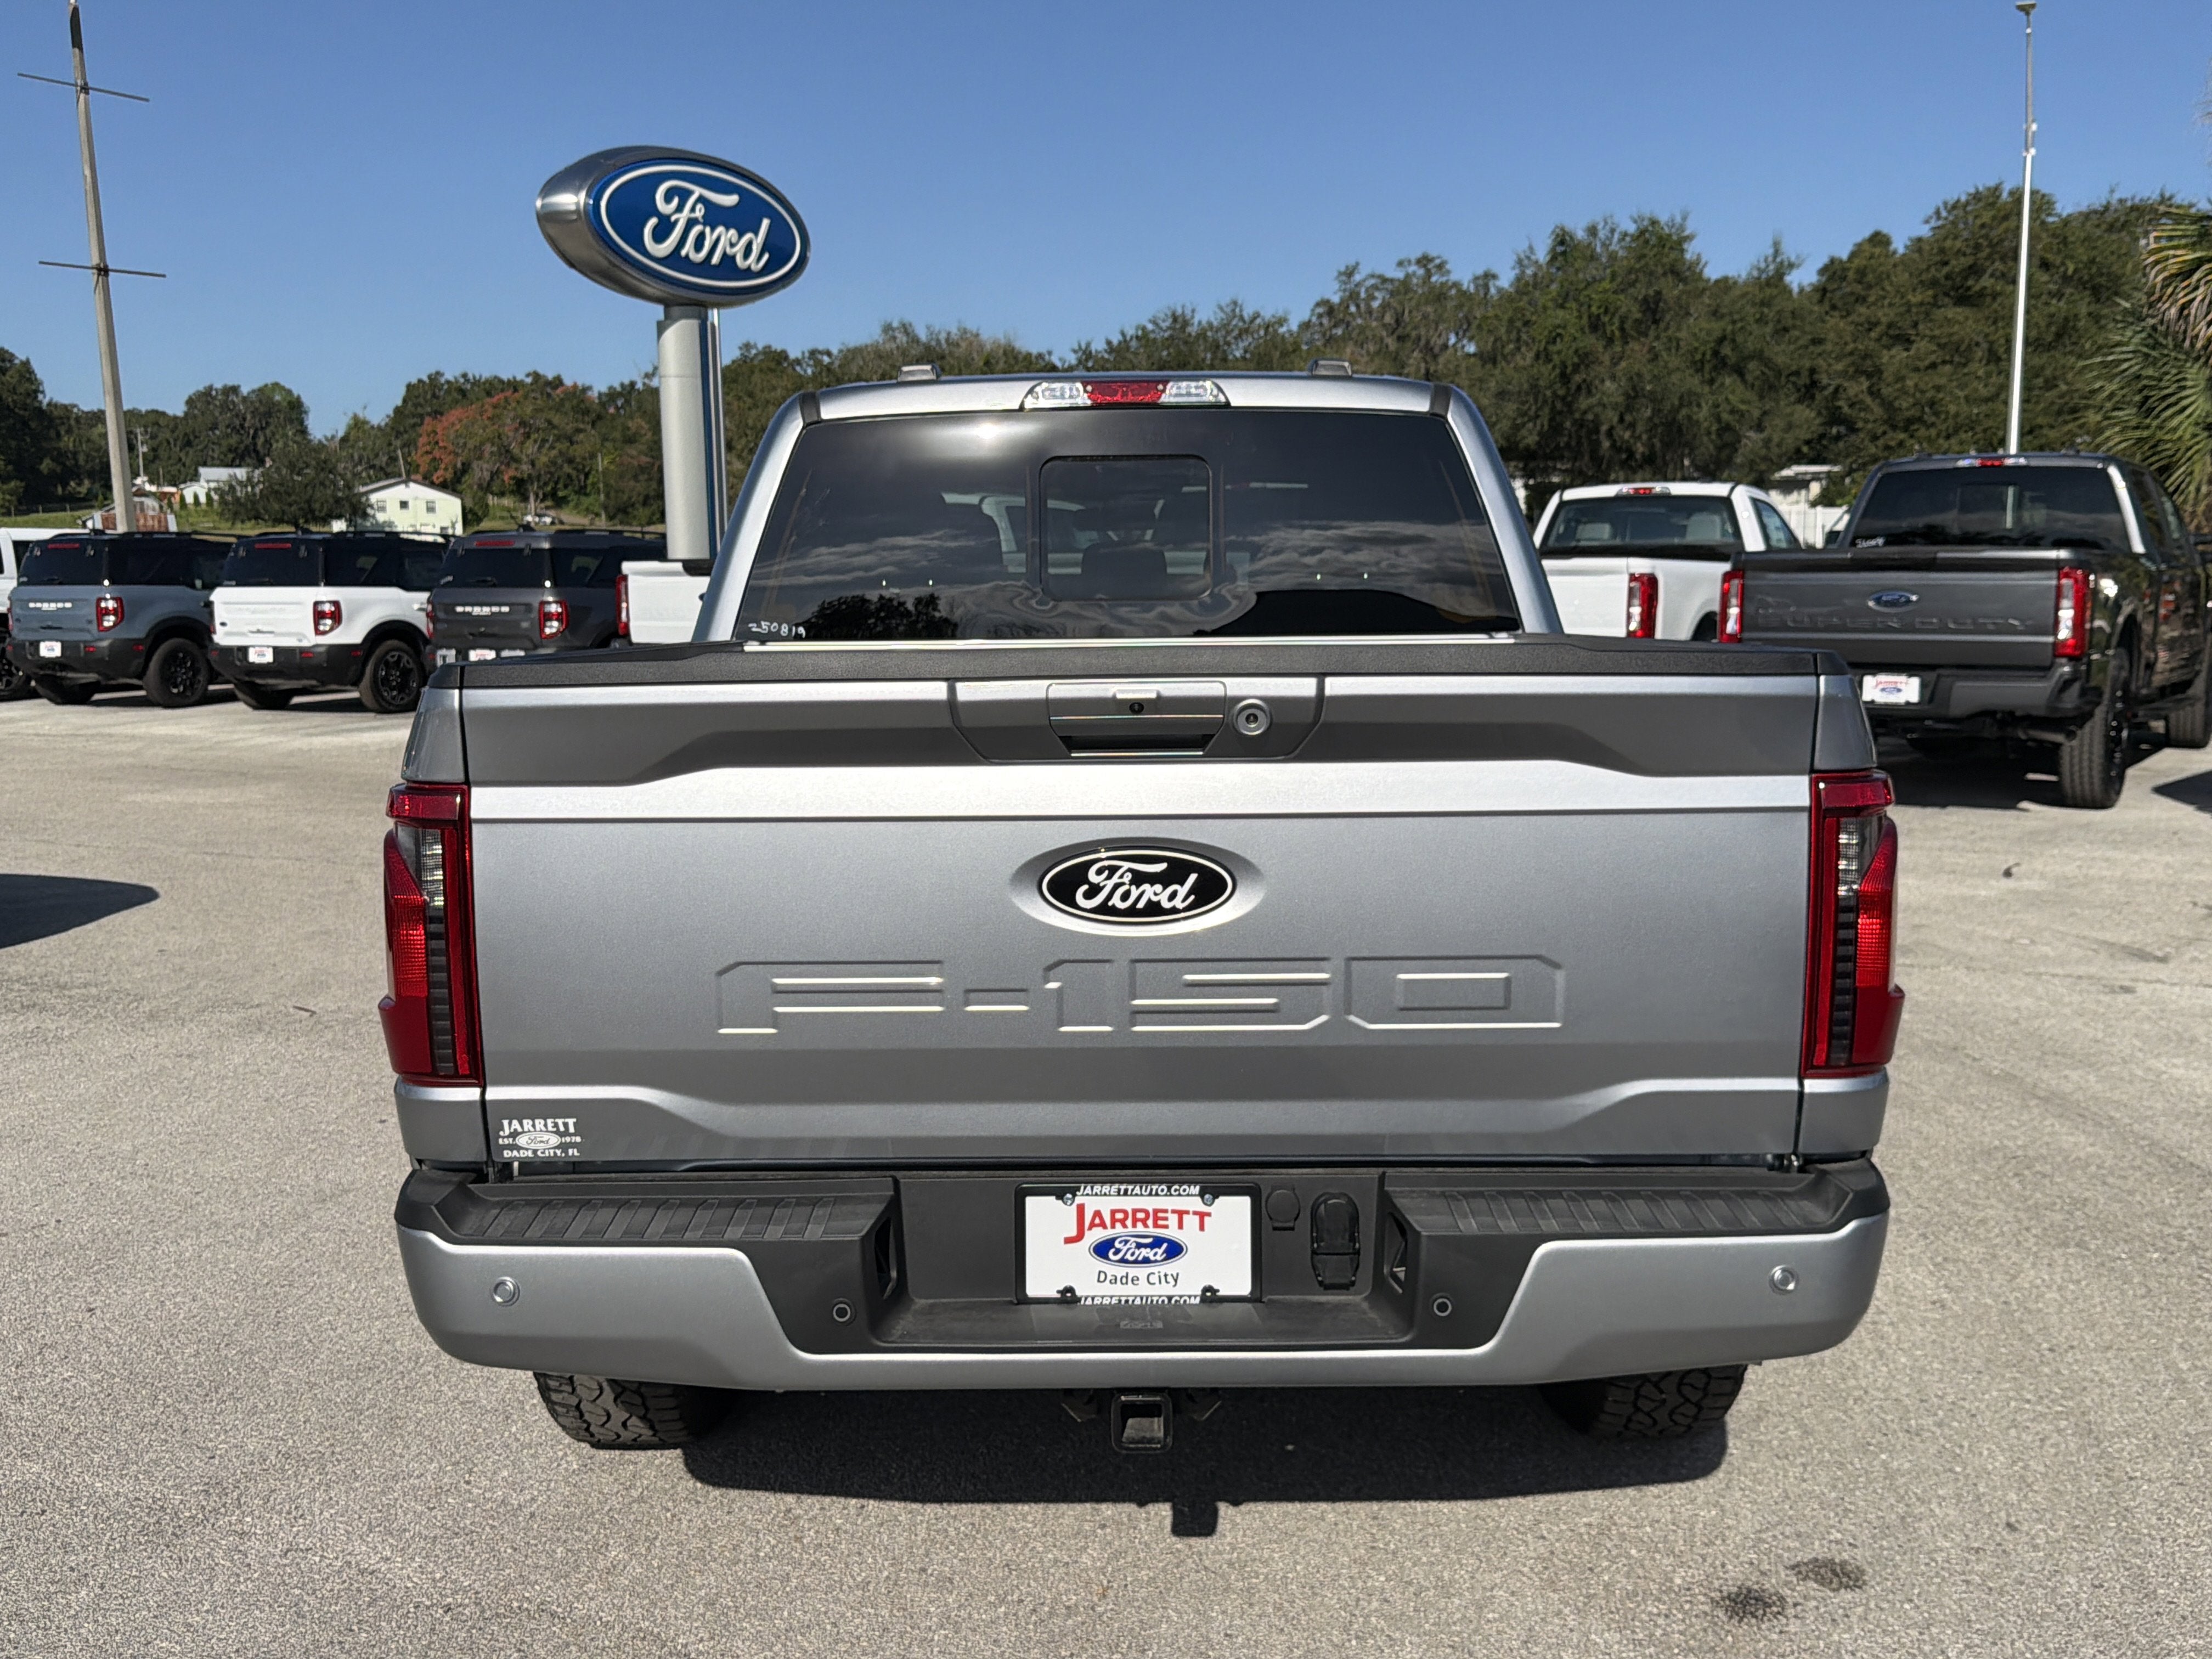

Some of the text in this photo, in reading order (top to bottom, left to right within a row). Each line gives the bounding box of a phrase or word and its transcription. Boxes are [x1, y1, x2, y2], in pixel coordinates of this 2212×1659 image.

[643, 180, 771, 273] Ford
[748, 620, 806, 639] 250819
[1075, 860, 1198, 909] Ford
[716, 955, 1565, 1034] F-150
[499, 1118, 577, 1136] JARRETT
[526, 1136, 551, 1145] Ford
[537, 1148, 565, 1157] CITY,
[1076, 1184, 1200, 1195] JARRETTAUTO.COM
[1064, 1203, 1212, 1245] JARRETT
[1108, 1236, 1168, 1261] Ford
[1097, 1270, 1180, 1287] Dade City
[1080, 1296, 1200, 1305] JARRETTAUTOCOM
